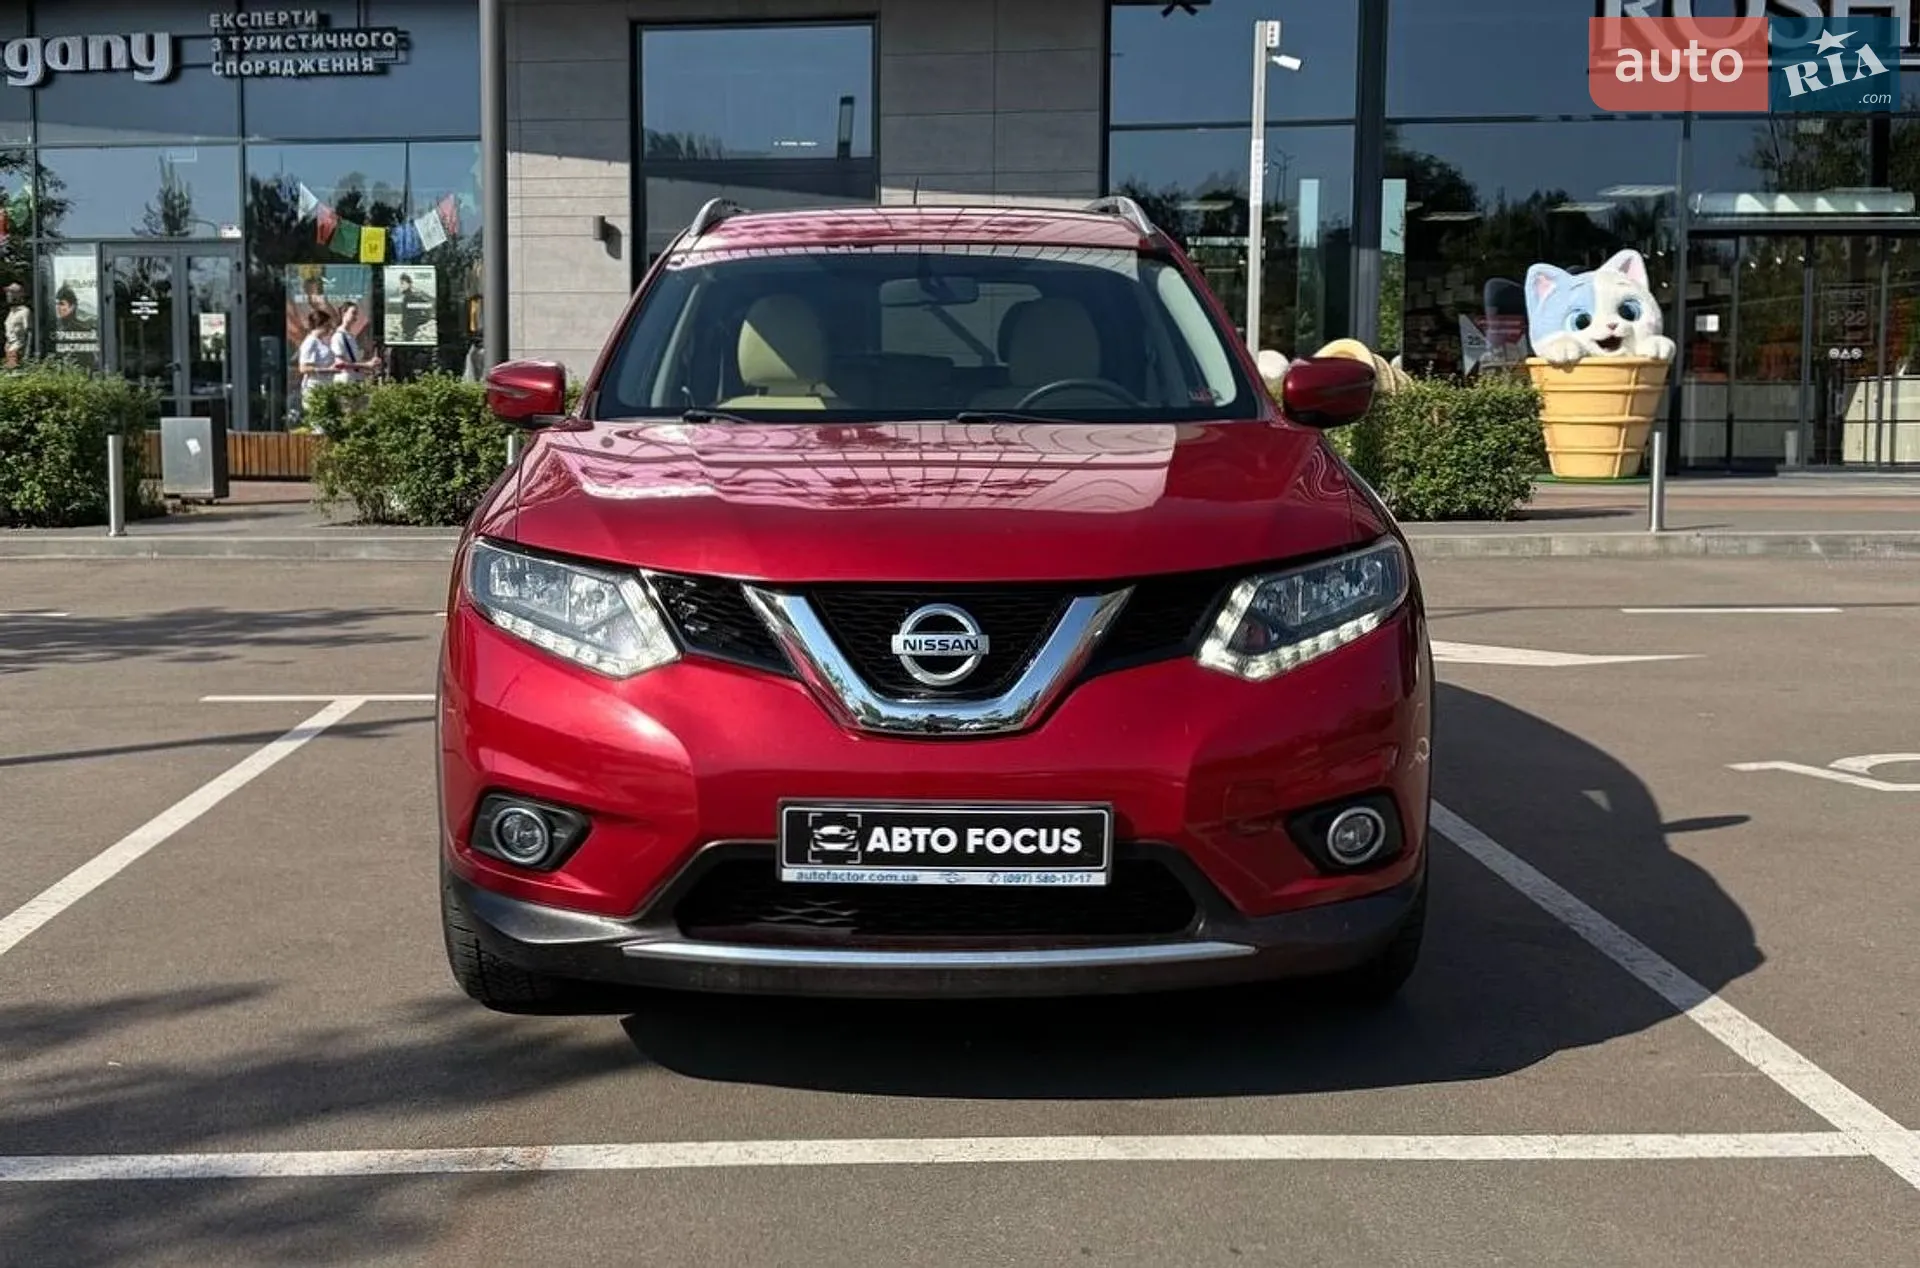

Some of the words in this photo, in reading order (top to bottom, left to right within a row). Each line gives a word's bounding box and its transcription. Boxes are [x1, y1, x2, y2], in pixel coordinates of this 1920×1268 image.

[209, 10, 318, 28] ЕКСПЕРТИ
[211, 37, 222, 52] З
[229, 32, 396, 51] ТУРИСТИЧНОГО
[4, 32, 173, 87] gany
[211, 57, 375, 76] СПОРЯДЖЕННЯ
[903, 639, 978, 651] NISSAN
[866, 826, 958, 854] АВТО
[966, 827, 1083, 854] FOCUS
[796, 870, 918, 883] autofactor.com.ua
